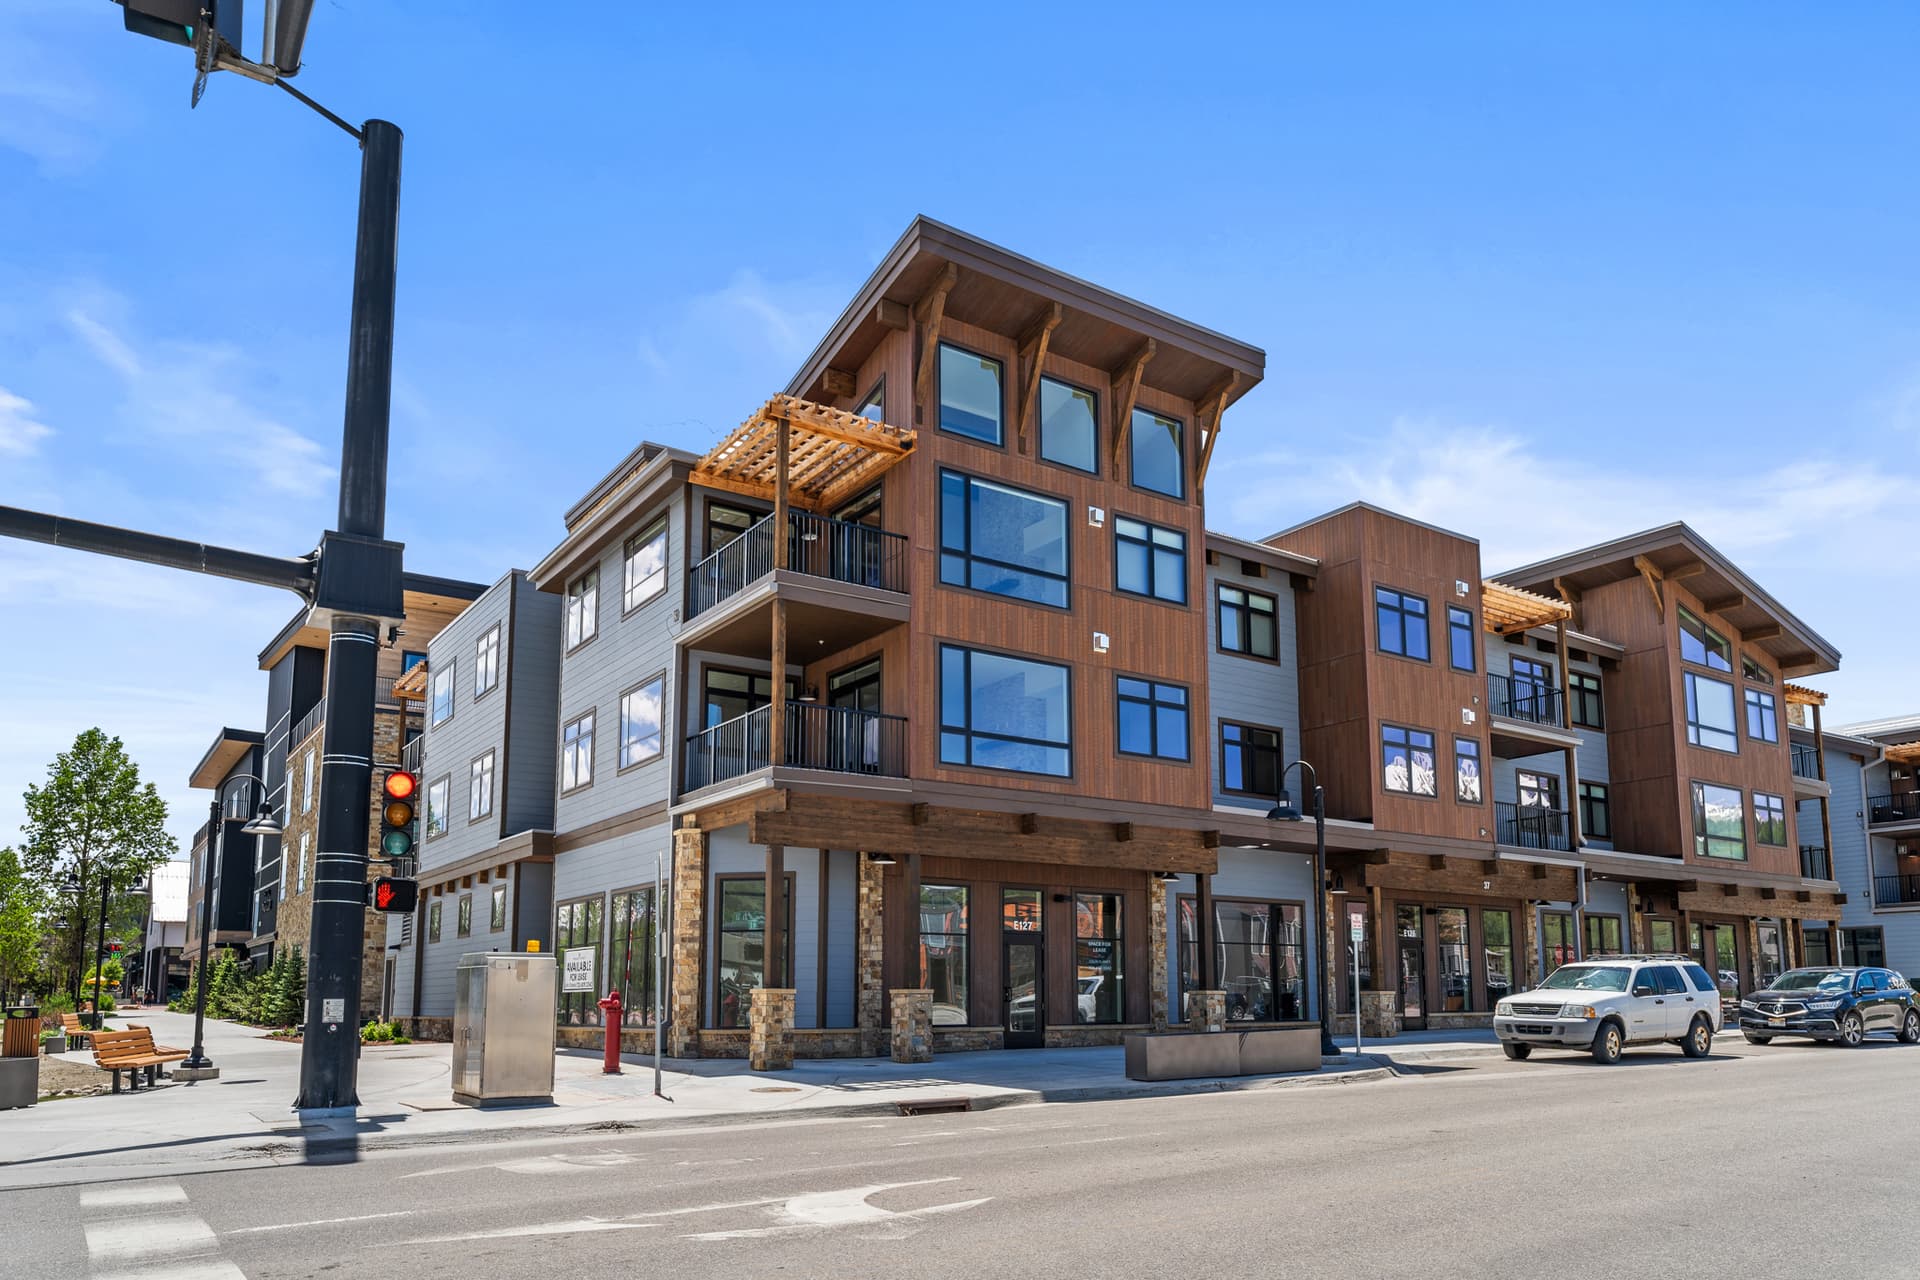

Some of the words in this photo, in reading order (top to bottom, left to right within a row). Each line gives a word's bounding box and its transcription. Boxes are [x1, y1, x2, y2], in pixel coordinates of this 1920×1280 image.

[1013, 920, 1033, 930] E127
[566, 960, 592, 973] AVAILABLE
[569, 973, 577, 982] FOR
[577, 972, 588, 981] LEASE
